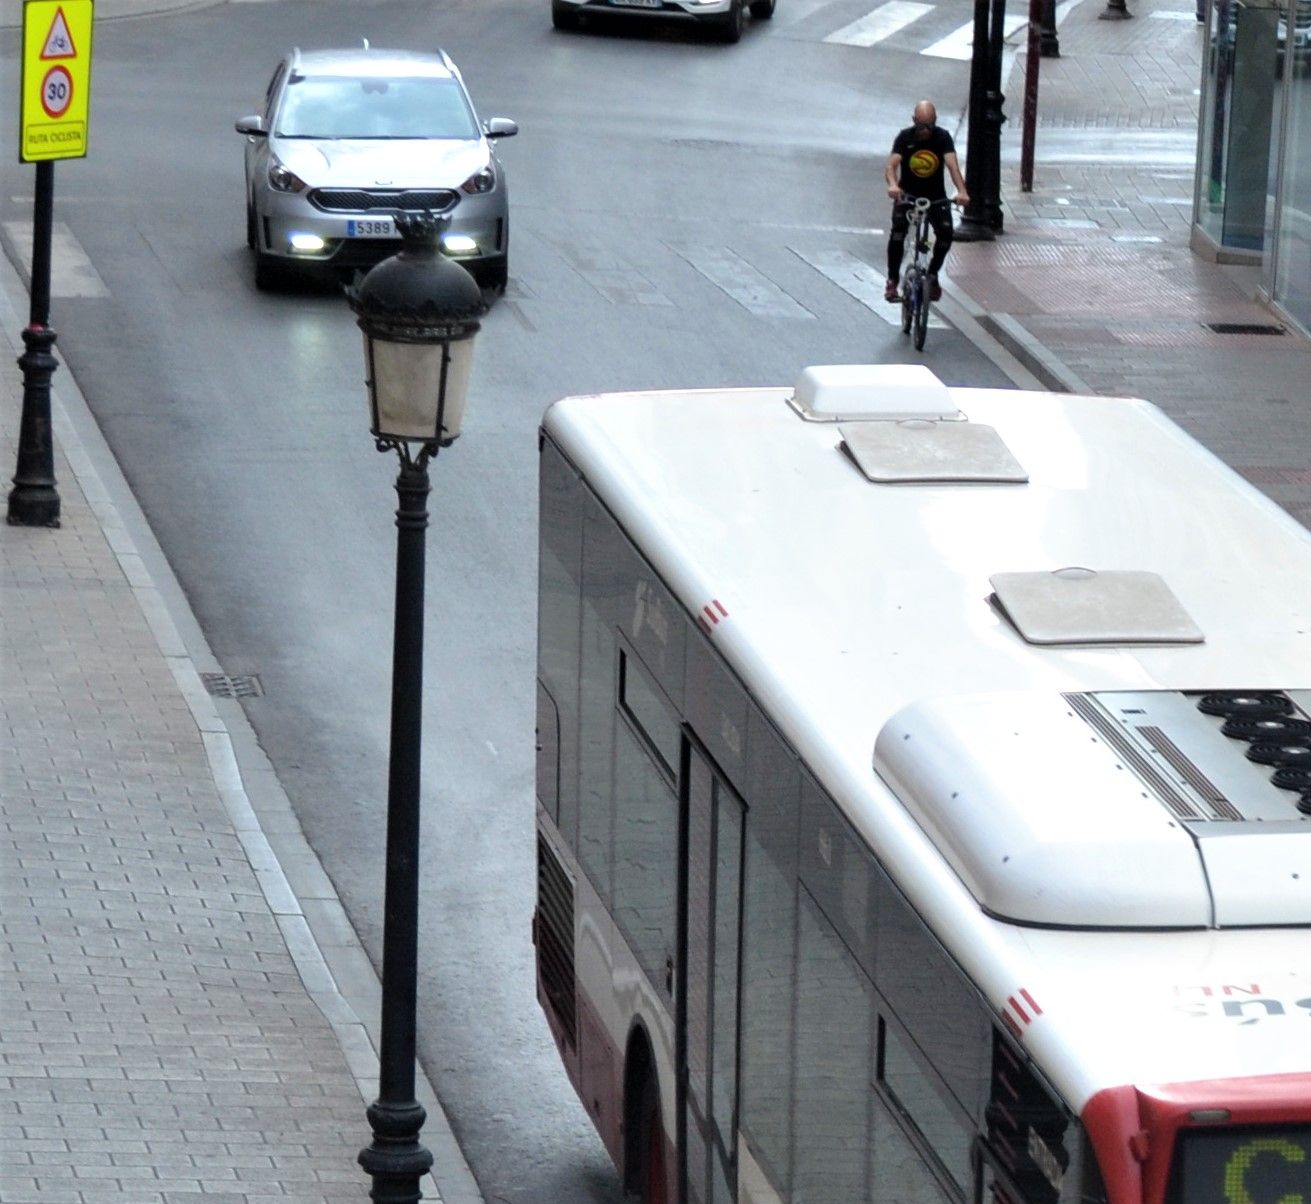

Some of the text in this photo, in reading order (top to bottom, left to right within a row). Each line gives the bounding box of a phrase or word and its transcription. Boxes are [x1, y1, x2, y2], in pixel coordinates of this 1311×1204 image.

[48, 83, 66, 100] 30
[29, 134, 48, 144] RUTA
[357, 222, 390, 234] 5389
